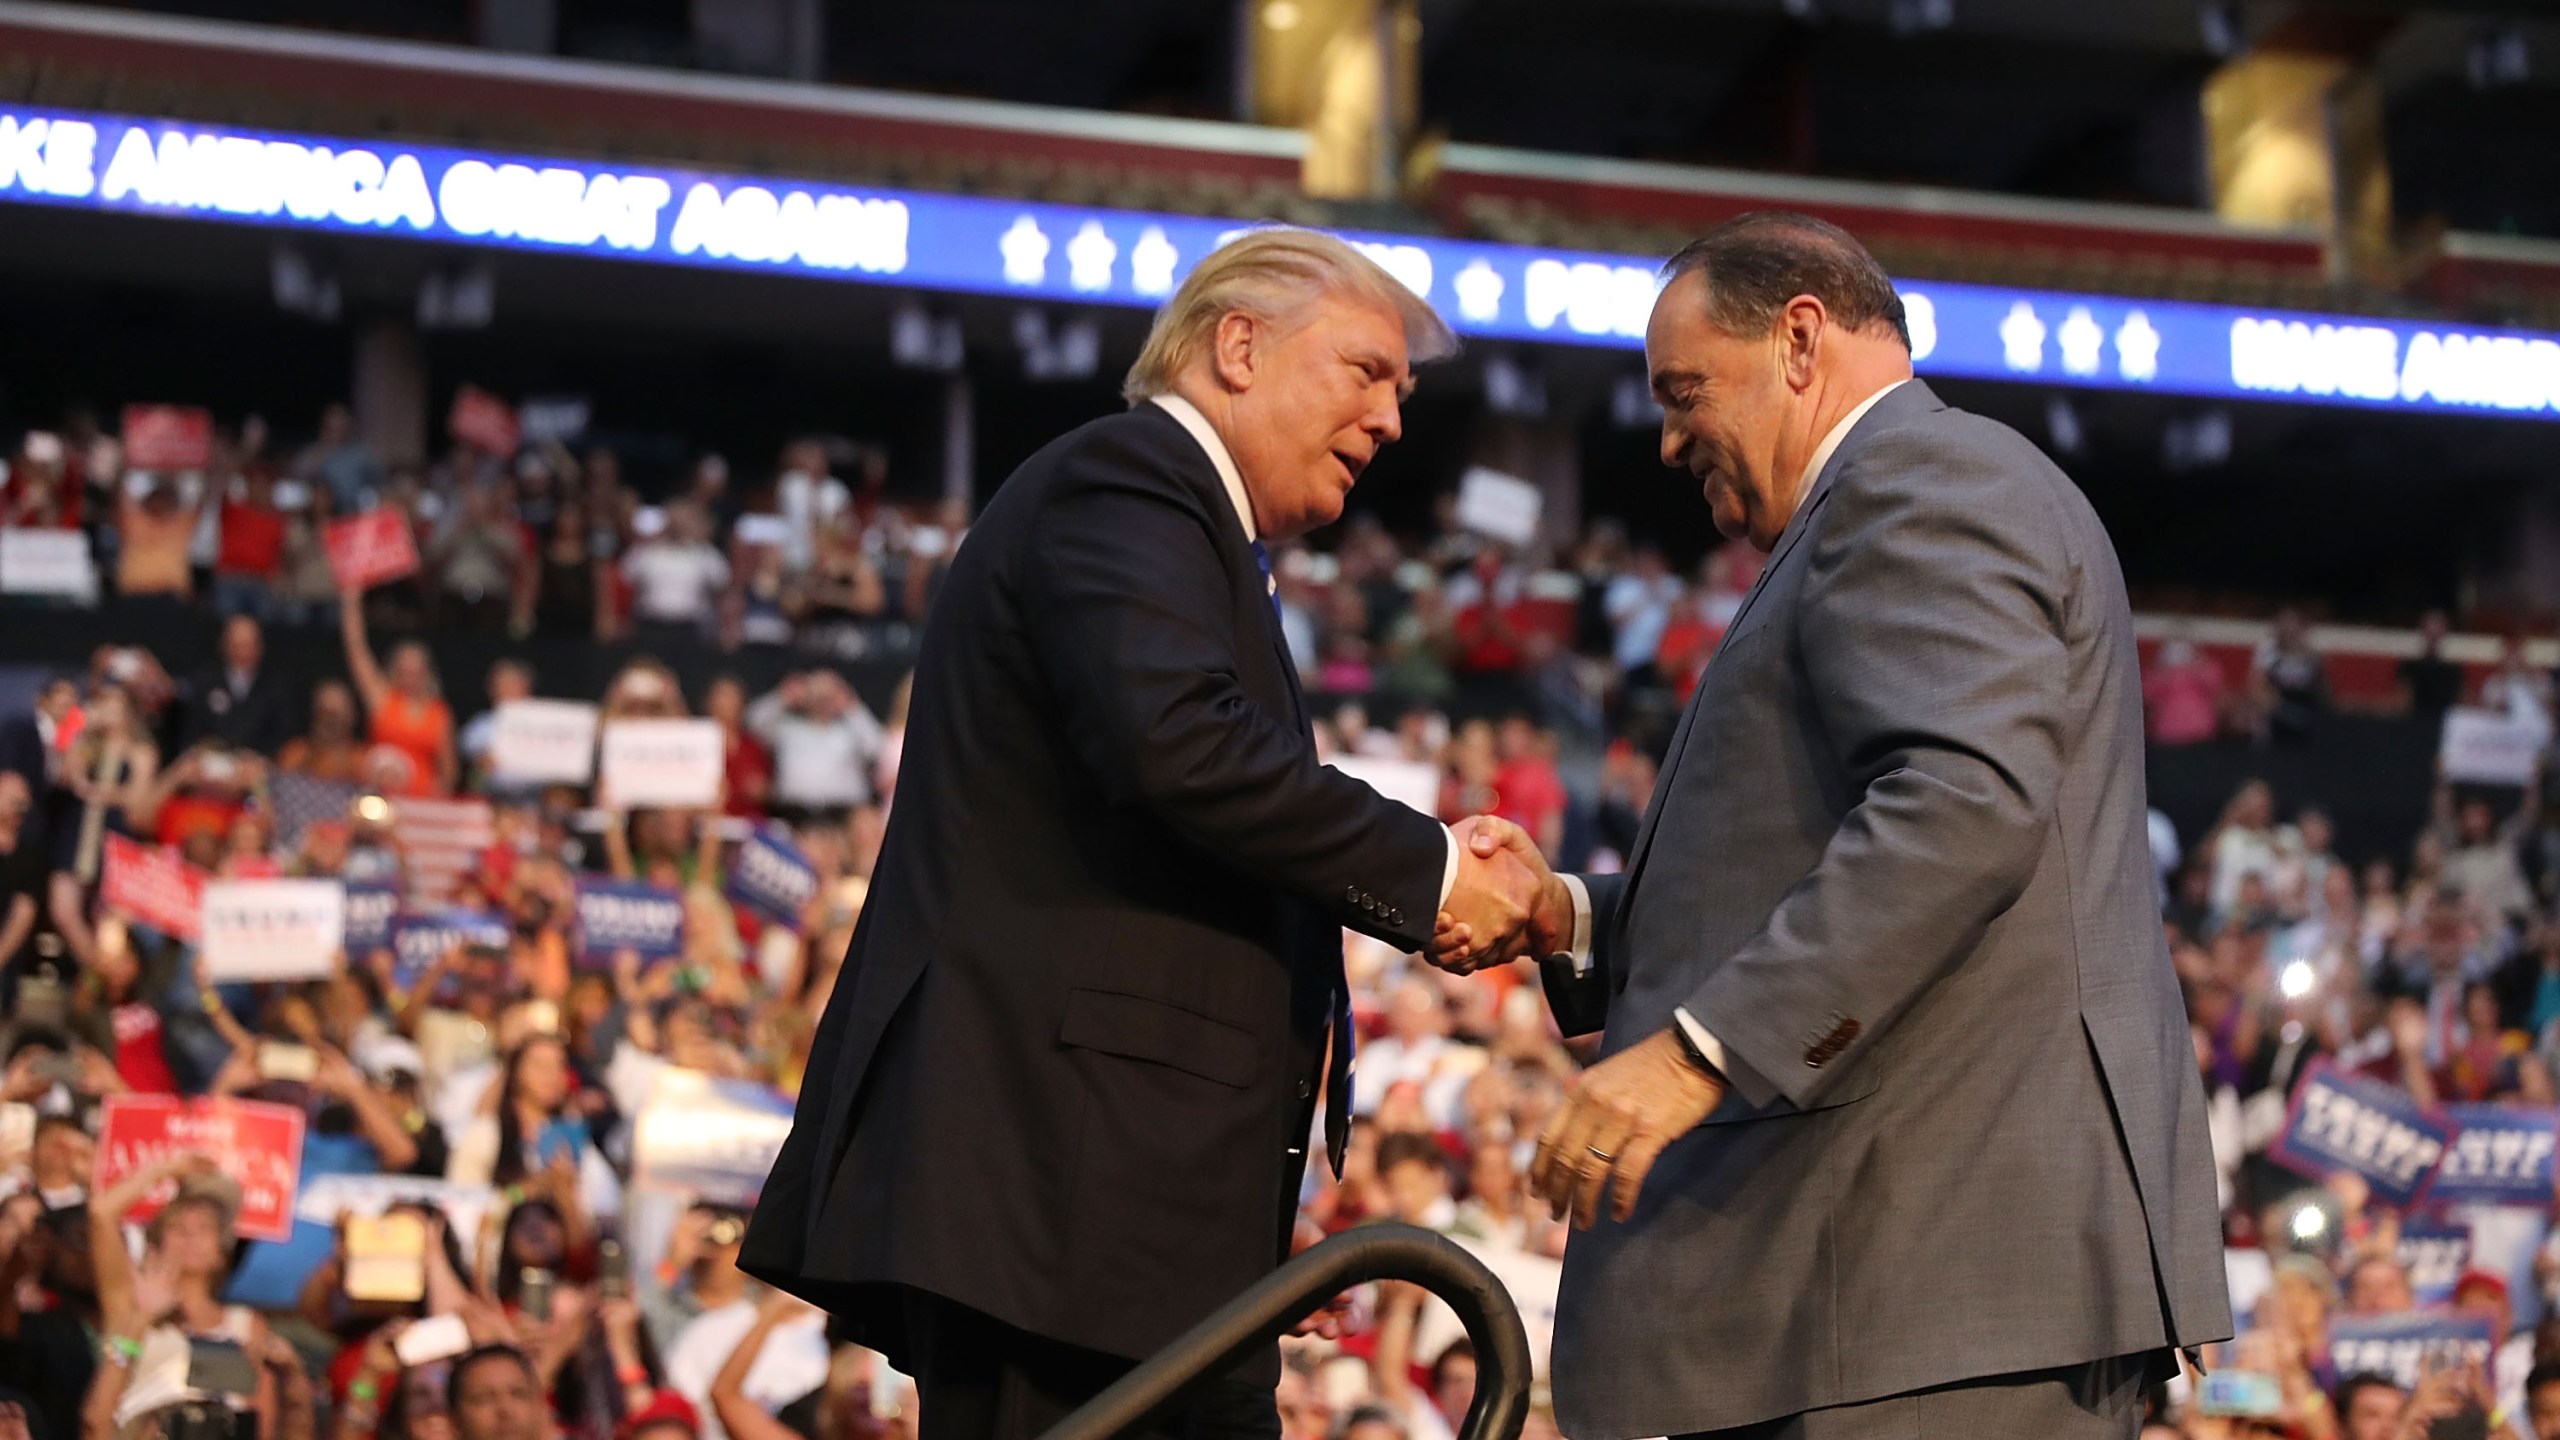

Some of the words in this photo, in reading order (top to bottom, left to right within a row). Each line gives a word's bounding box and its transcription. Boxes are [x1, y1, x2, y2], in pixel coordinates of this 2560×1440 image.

[102, 127, 436, 230] AMERICA
[439, 160, 671, 251] GREAT
[2231, 317, 2398, 400] MAKE
